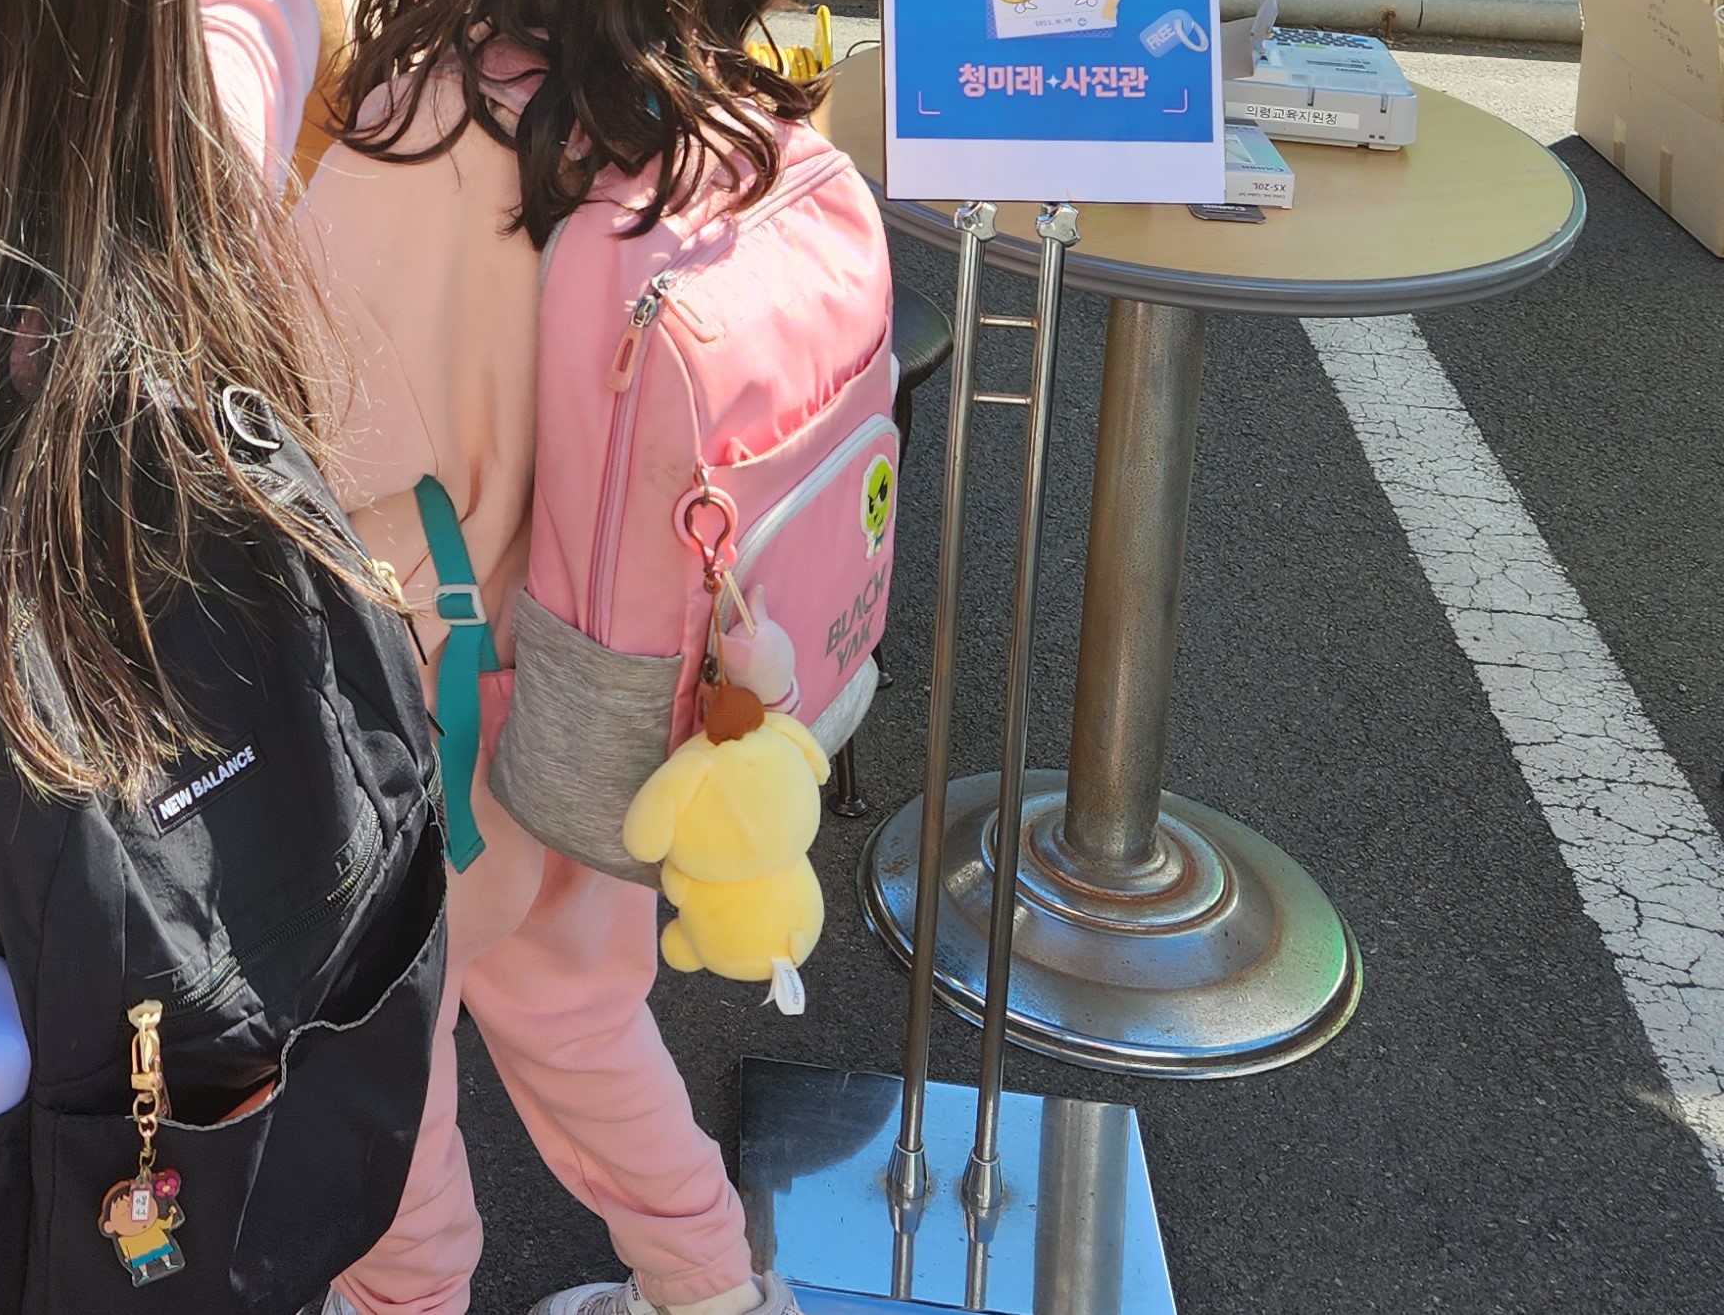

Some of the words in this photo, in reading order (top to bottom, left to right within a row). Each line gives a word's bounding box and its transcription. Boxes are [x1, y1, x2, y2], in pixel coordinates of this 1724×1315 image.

[1144, 21, 1177, 53] FREE
[957, 62, 1045, 98] 청미래
[1059, 64, 1150, 99] 사진관
[1245, 104, 1338, 126] 의령교육지원청
[1252, 182, 1287, 192] XS-20L
[825, 563, 887, 658] BLACK
[158, 787, 194, 821] NEW
[190, 745, 256, 799] BALANCE
